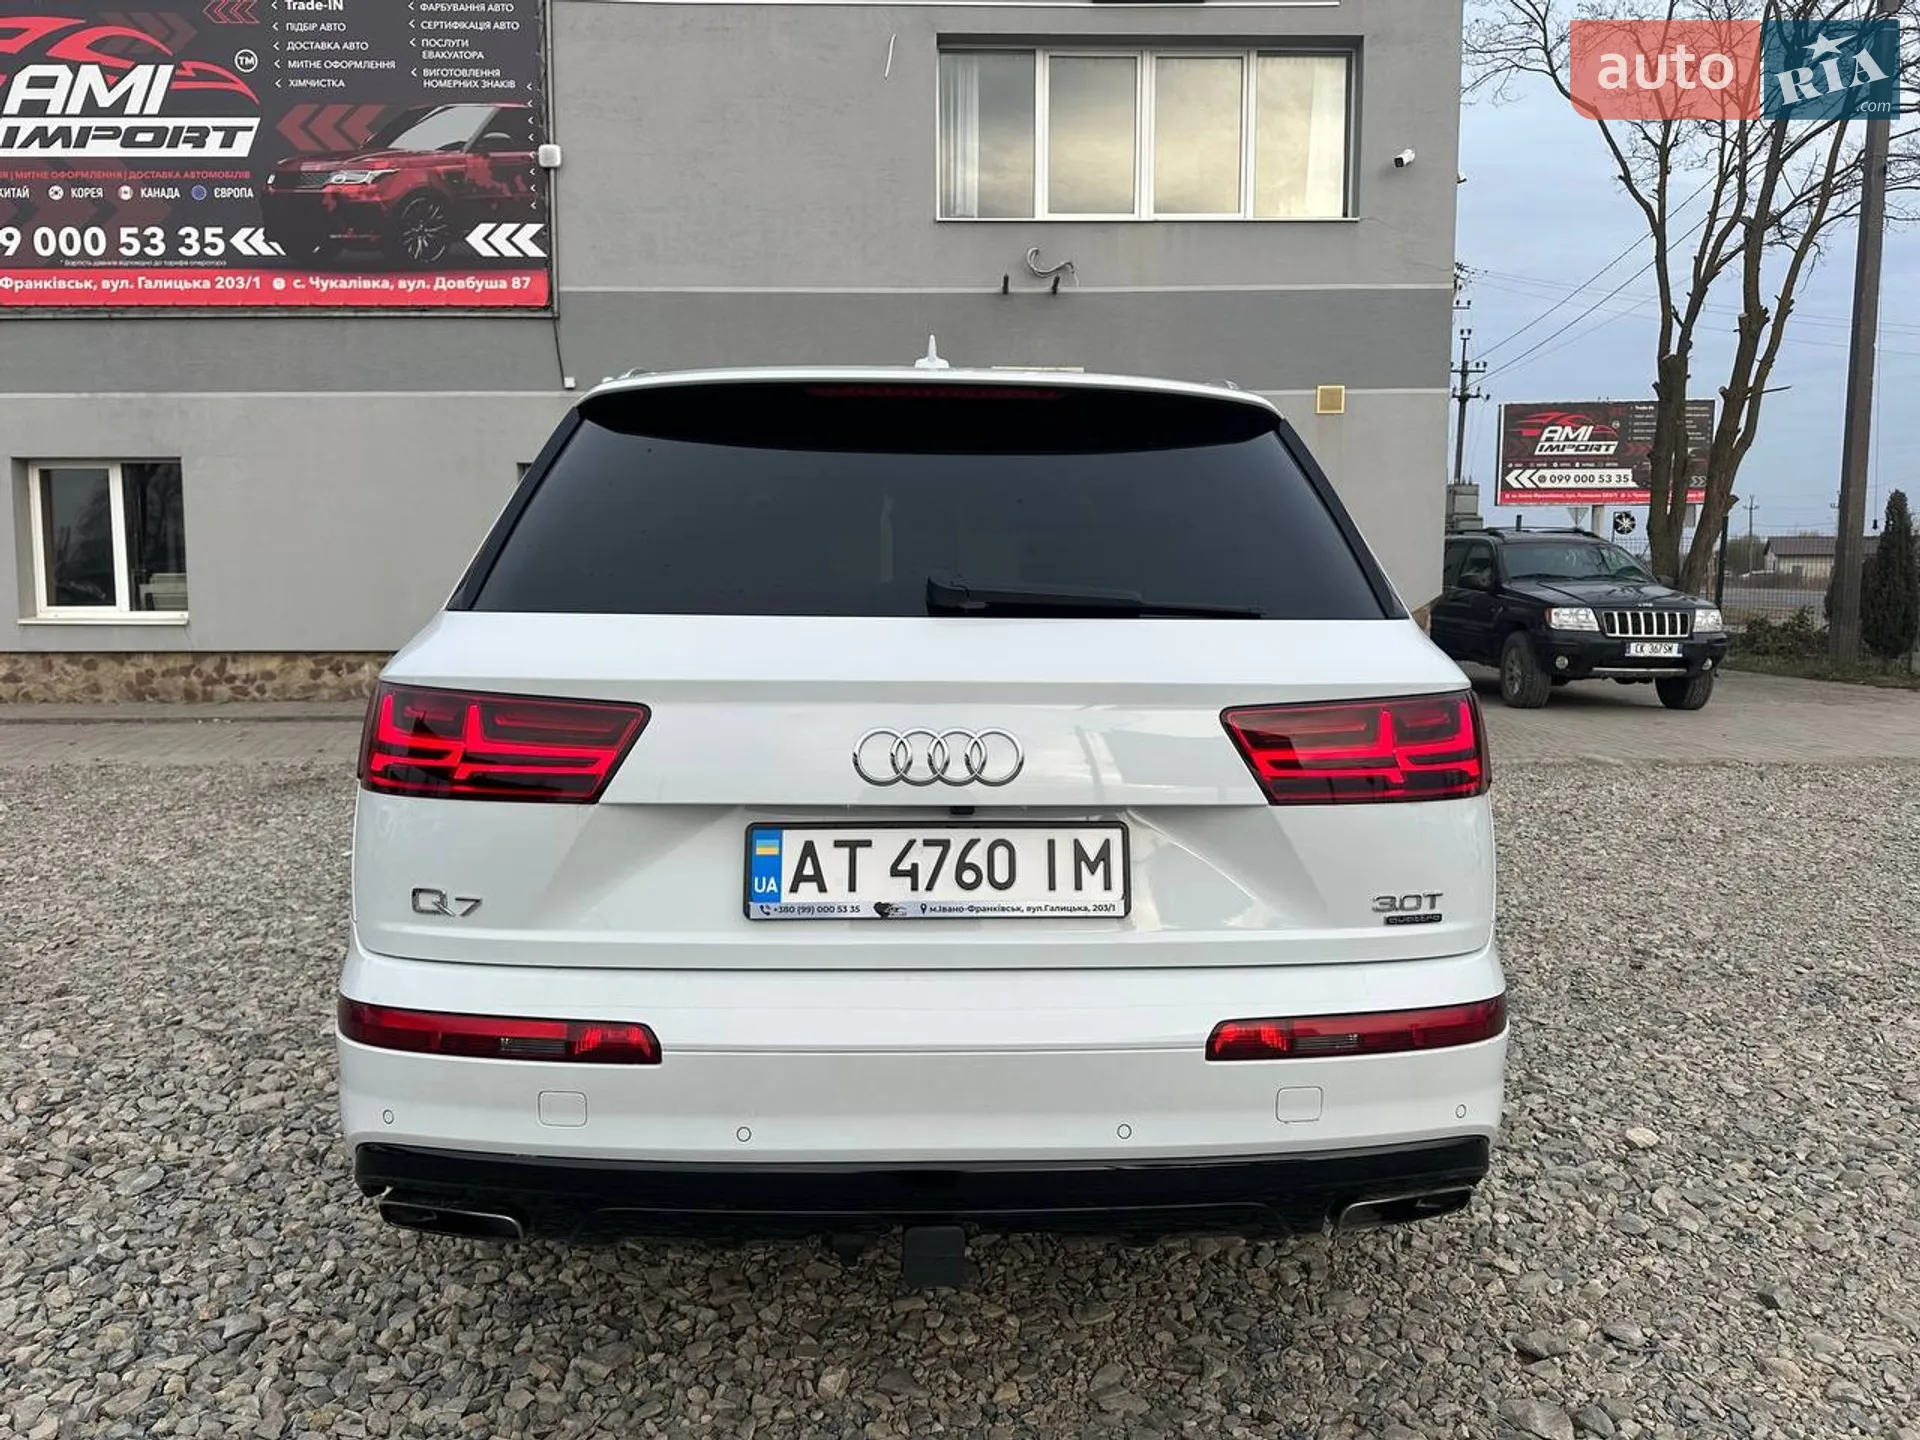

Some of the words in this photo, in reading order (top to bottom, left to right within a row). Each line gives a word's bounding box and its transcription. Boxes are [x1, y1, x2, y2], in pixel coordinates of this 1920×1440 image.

[286, 0, 344, 10] Trade-IN
[419, 3, 486, 12] ФАРБУВАННЯ
[487, 3, 515, 12] АВТО
[286, 22, 318, 32] ПІДБІР
[319, 22, 347, 31] АВТО
[420, 20, 491, 31] СЕРТИФІКАЦІЯ
[492, 20, 520, 30] АВТО
[286, 41, 340, 51] ДОСТАВКА
[342, 41, 369, 51] АВТО
[421, 38, 469, 48] ПОСЛУГИ
[421, 51, 485, 60] ЕВАКУАТОРА
[287, 60, 322, 69] МИТНЕ
[323, 60, 396, 70] ОФОРМЛЕННЯ
[422, 68, 501, 78] ВИГОТОВЛЕННЯ
[288, 79, 346, 88] ХІМЧИСТКА
[423, 80, 479, 89] НОМЕРНИХ
[481, 80, 516, 89] ЗНАКІВ
[2, 64, 175, 115] AMI
[1, 126, 254, 149] IMPORT
[129, 170, 181, 180] ДОСТАВКА
[70, 187, 104, 198] КОРЕЯ
[140, 187, 181, 199] КАНАДА
[213, 187, 254, 198] ЄВРОПА
[33, 226, 107, 257] 000
[118, 226, 166, 257] 53
[177, 226, 226, 257] 35
[0, 276, 98, 293] Франківськ,
[101, 279, 134, 292] вул.
[137, 276, 211, 291] Галицька
[215, 276, 261, 290] 203/1
[293, 279, 305, 289] с.
[309, 276, 395, 292] Чукалівка,
[398, 279, 429, 292] вул.
[433, 276, 507, 291] Довбуша
[511, 276, 531, 289] 87
[1540, 425, 1594, 441] AMI
[1537, 443, 1616, 453] IMPORT
[1549, 474, 1570, 483] 099
[1573, 474, 1595, 483] 000
[1598, 474, 1612, 483] 53
[1615, 474, 1630, 482] 35
[789, 839, 872, 894] AT
[889, 838, 1016, 892] 4760
[1046, 838, 1112, 891] IM
[754, 876, 778, 894] UA
[411, 887, 483, 918] Q7
[1092, 903, 1116, 912] 203/1
[773, 905, 795, 913] +380
[797, 904, 815, 915] (99)
[816, 905, 835, 913] 000
[837, 905, 848, 913] 53
[849, 905, 861, 913] 35
